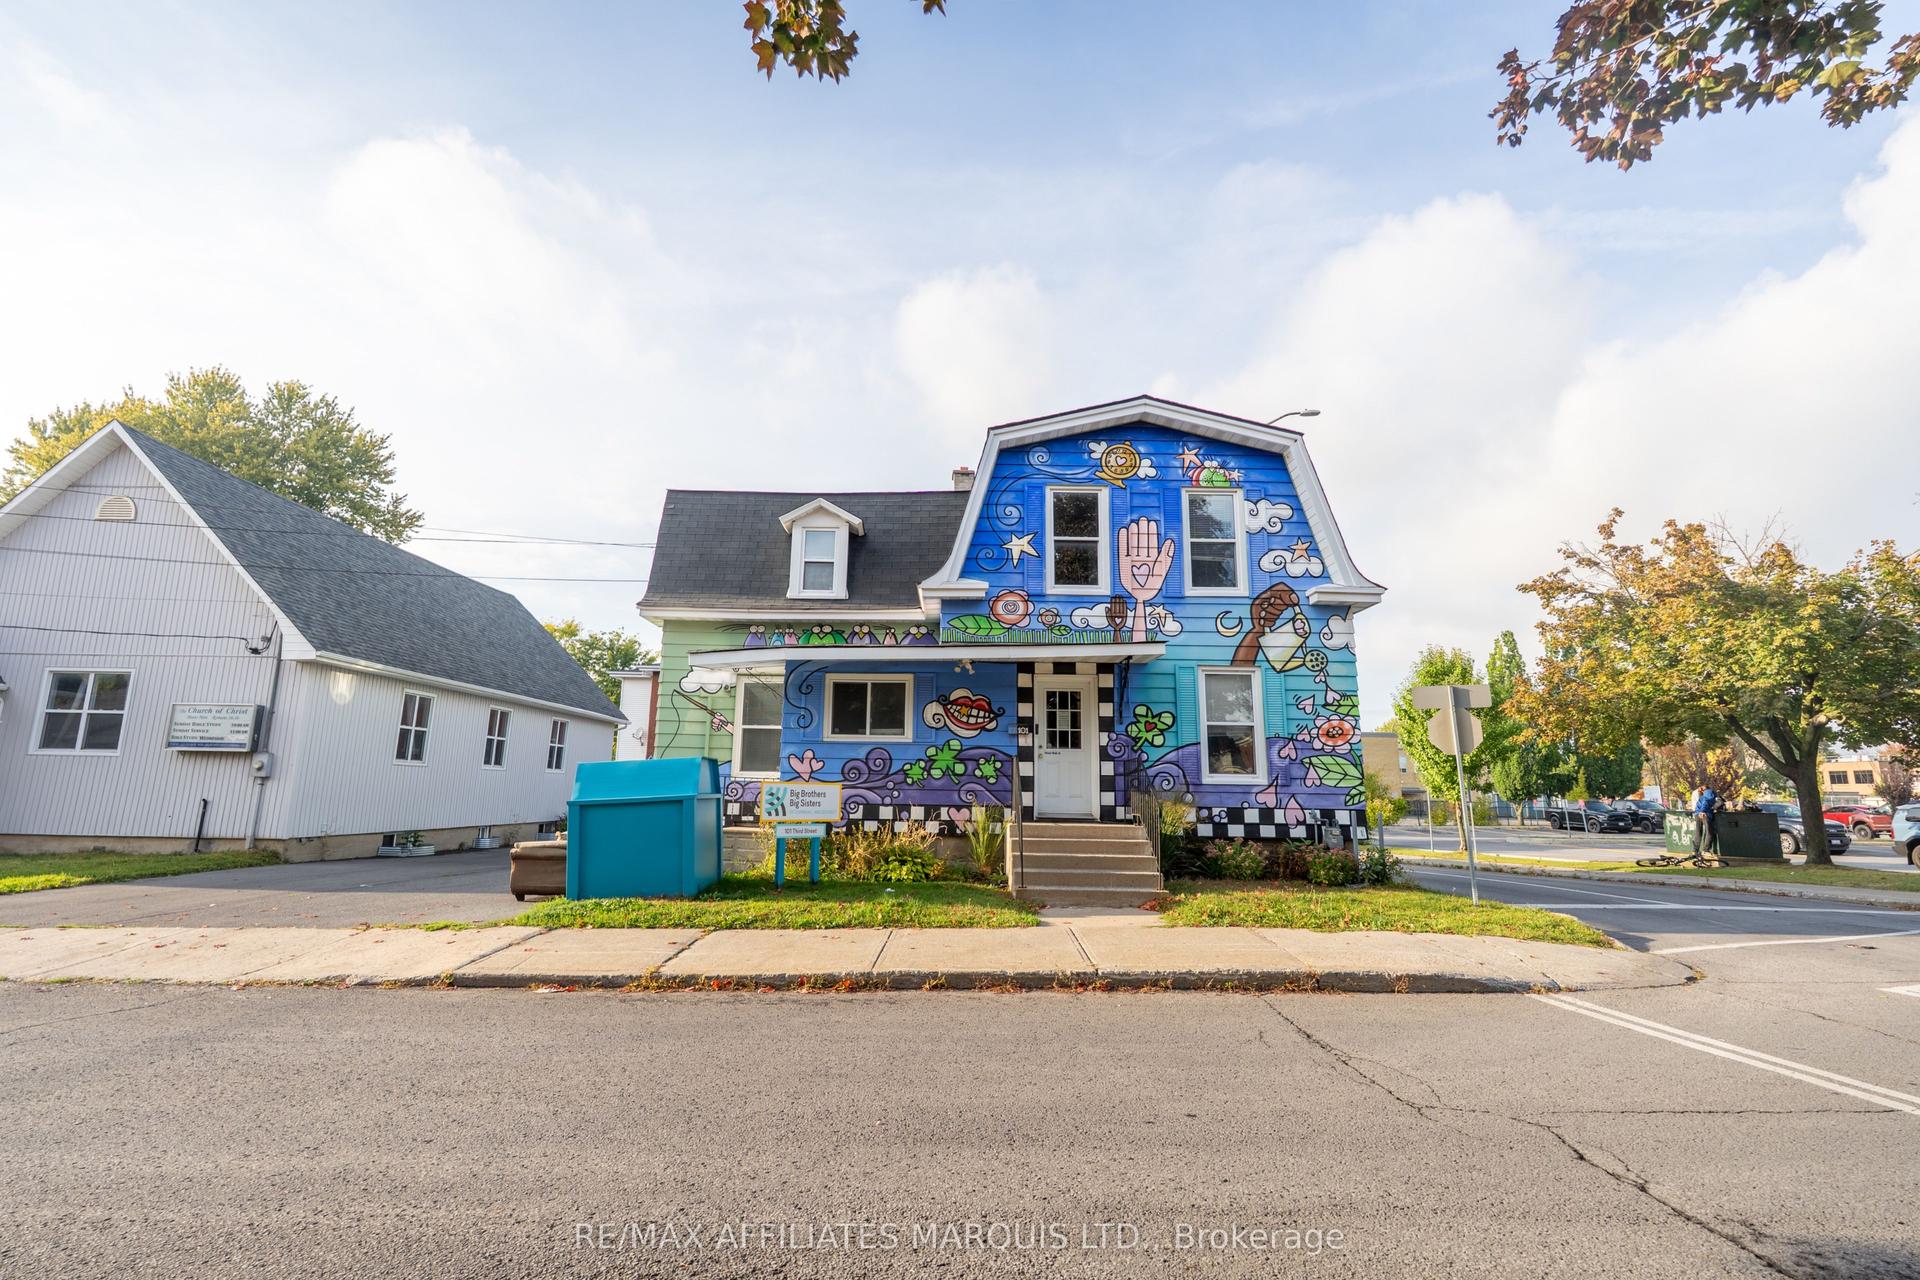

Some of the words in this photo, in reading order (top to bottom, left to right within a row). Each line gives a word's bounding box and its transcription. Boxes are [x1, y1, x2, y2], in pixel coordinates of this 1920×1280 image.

[789, 789, 800, 799] Big
[800, 789, 827, 798] Brothers
[789, 799, 800, 809] Big
[800, 799, 821, 808] Sisters
